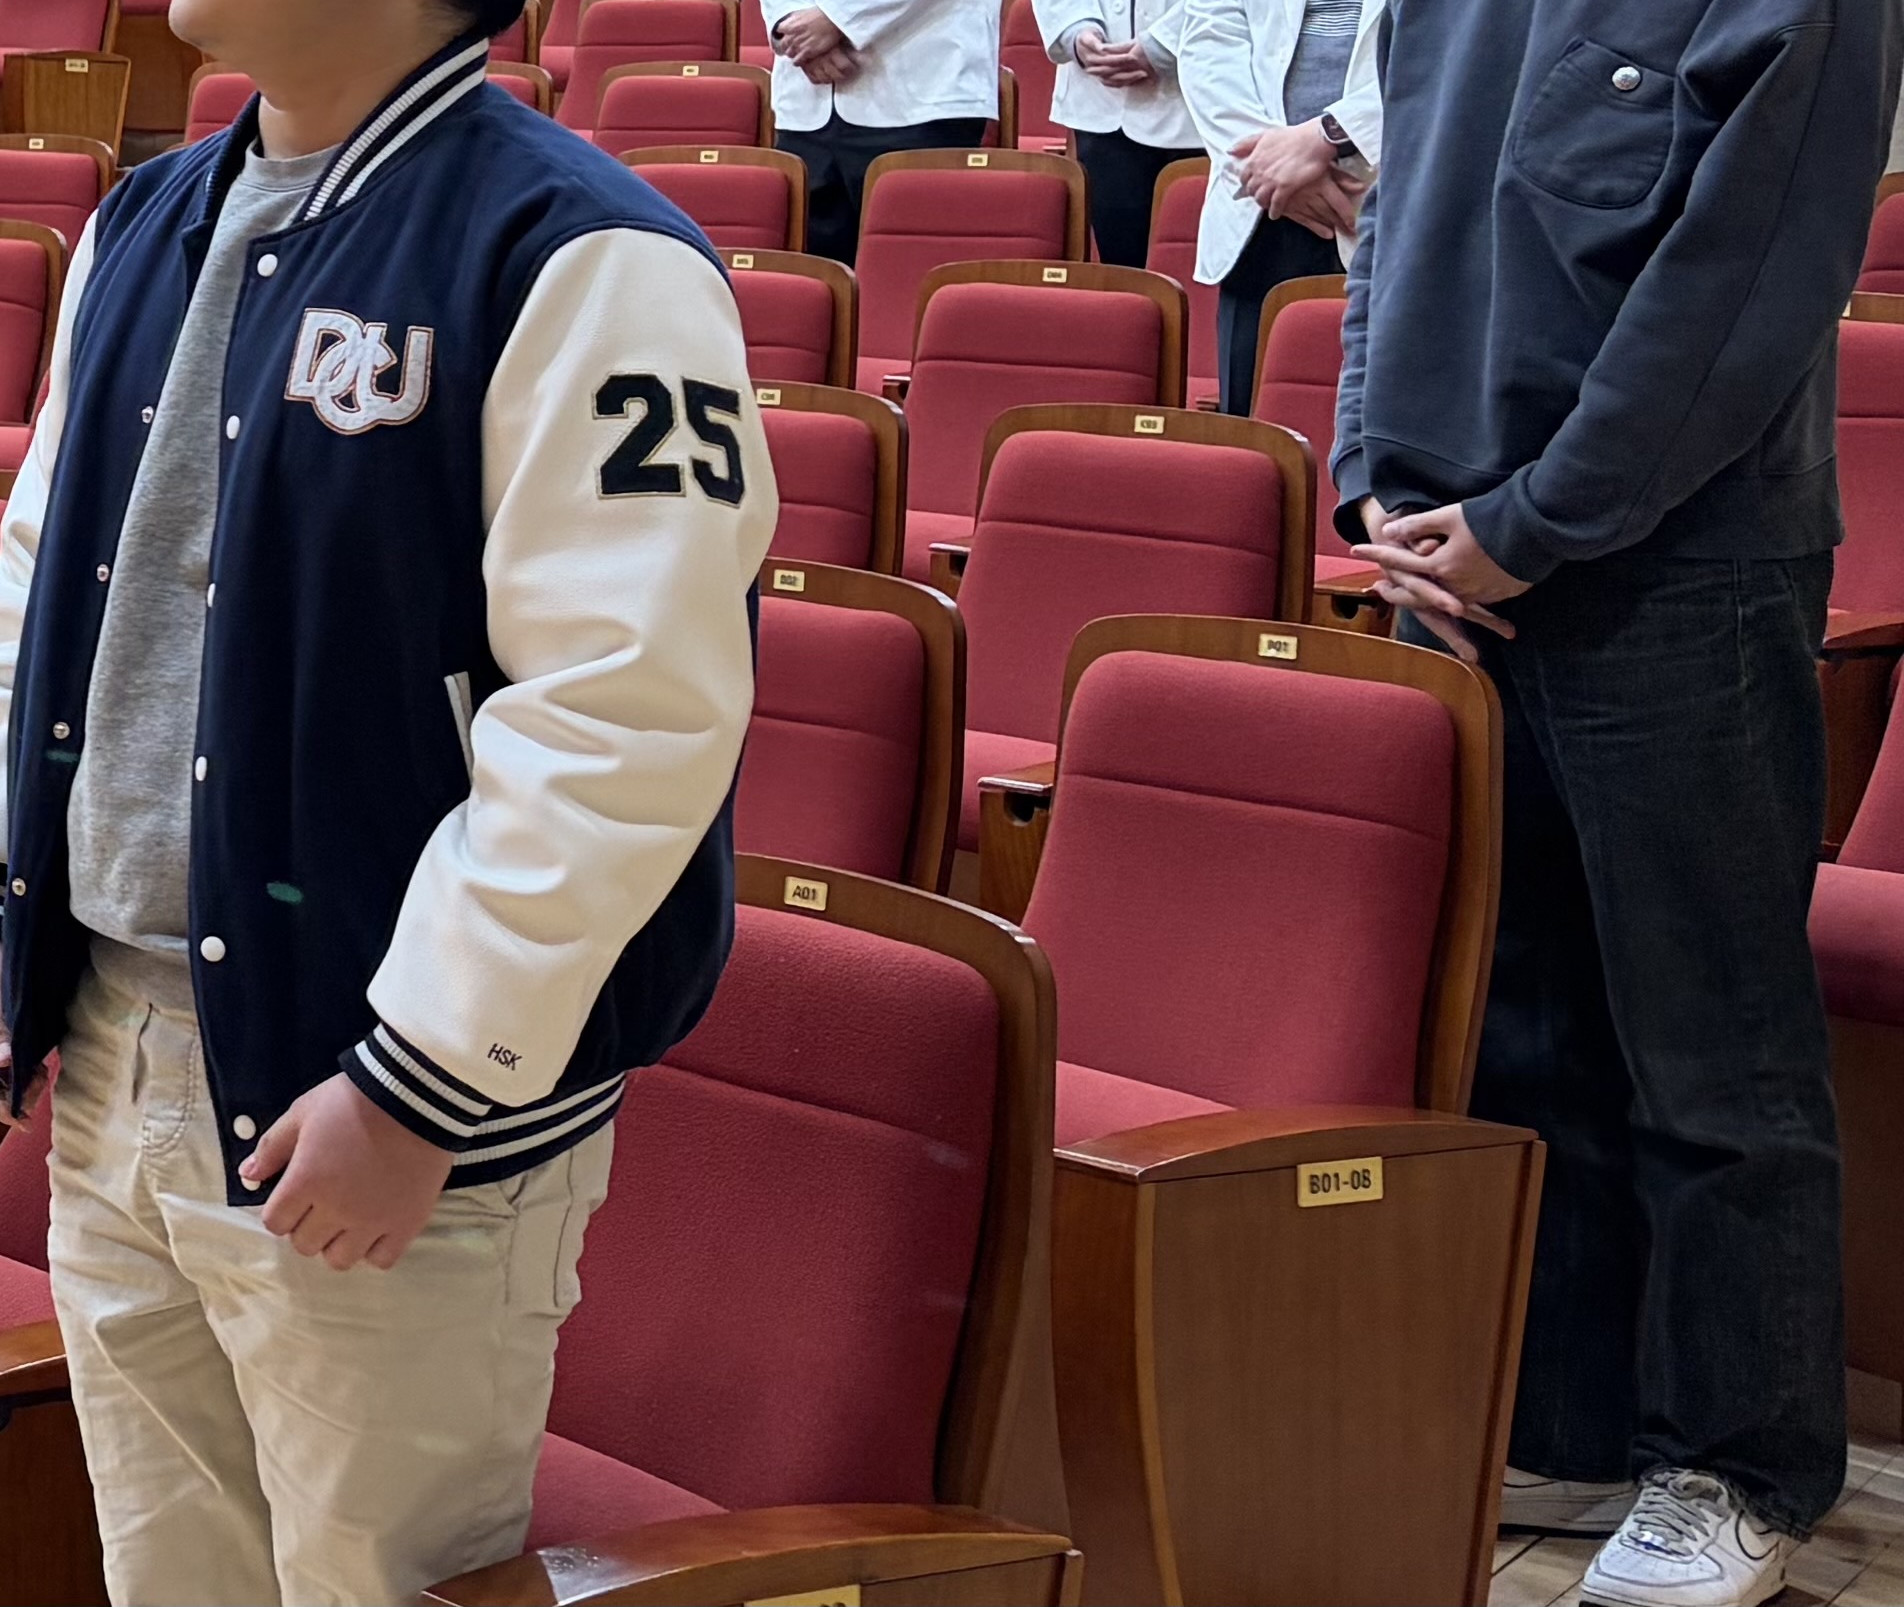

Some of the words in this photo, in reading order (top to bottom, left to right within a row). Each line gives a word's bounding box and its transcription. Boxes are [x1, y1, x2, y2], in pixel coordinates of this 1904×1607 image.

[594, 370, 745, 509] 25
[792, 885, 817, 901] A01
[487, 1043, 523, 1071] HSK
[1309, 1168, 1372, 1194] B01-08
